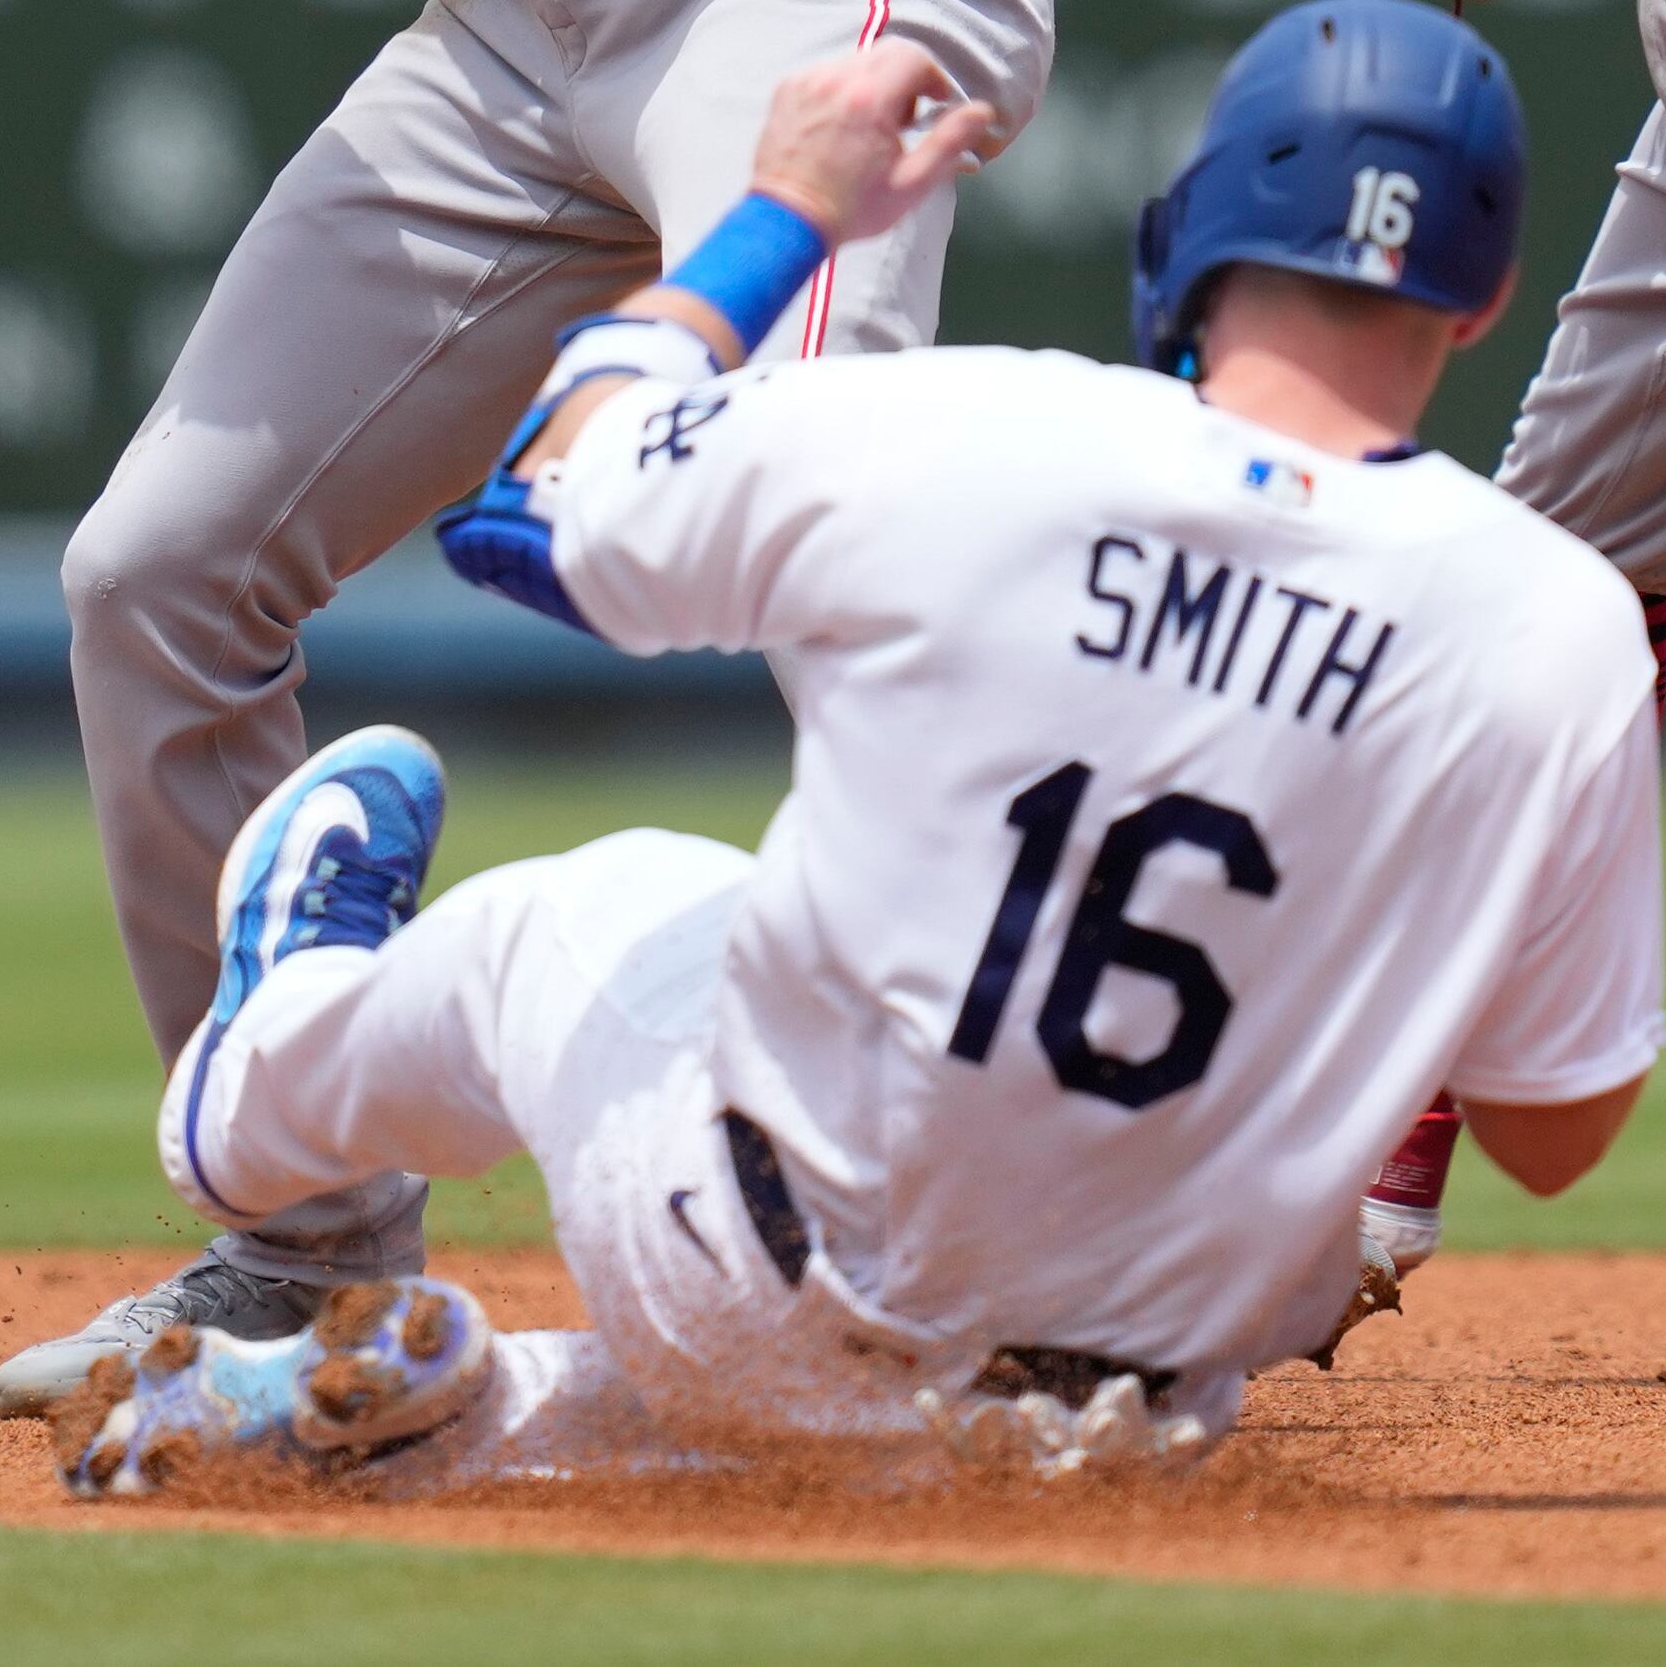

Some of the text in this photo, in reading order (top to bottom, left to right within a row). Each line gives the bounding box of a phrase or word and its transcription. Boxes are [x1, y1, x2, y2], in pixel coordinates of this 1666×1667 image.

[1345, 165, 1421, 249] 16
[1076, 532, 1398, 736] SMITH
[946, 759, 1281, 1110] 16
